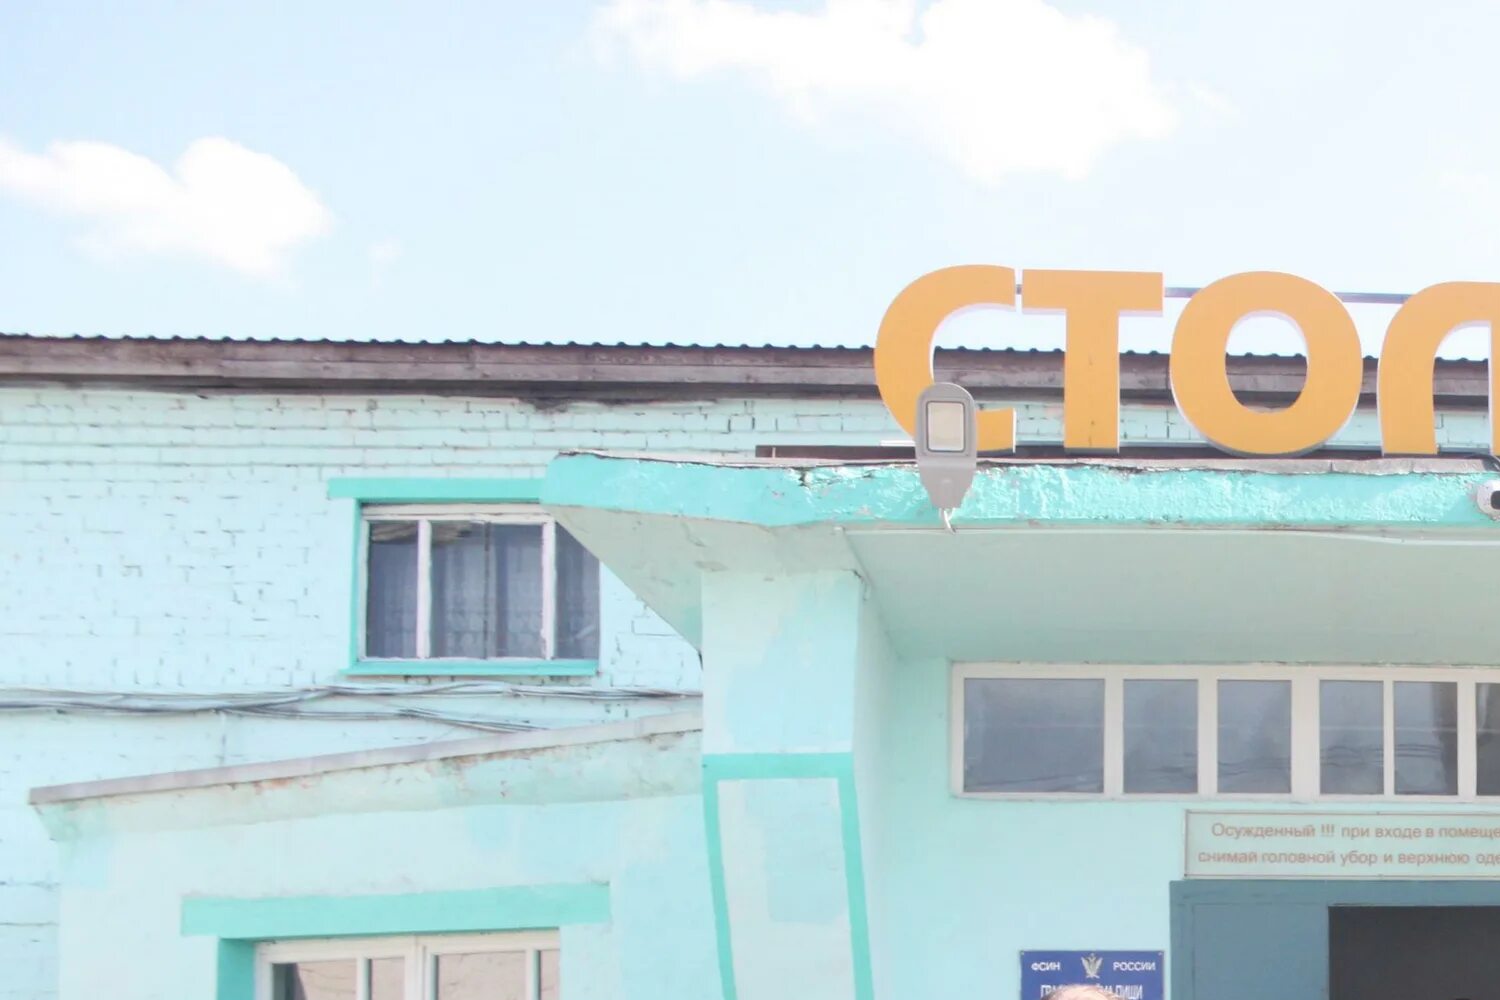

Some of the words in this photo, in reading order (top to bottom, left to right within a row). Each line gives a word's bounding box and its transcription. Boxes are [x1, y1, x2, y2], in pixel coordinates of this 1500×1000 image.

[1211, 823, 1316, 839] Осужденный
[1321, 824, 1335, 837] !!!
[1341, 826, 1370, 840] при
[1375, 827, 1422, 839] входе
[1426, 829, 1434, 838] в
[1198, 851, 1257, 863] снимай
[1262, 850, 1336, 863] головной
[1340, 850, 1378, 866] убор
[1383, 854, 1393, 864] и
[1398, 853, 1470, 867] верхнюю
[1031, 962, 1061, 971] ФСИН
[1113, 962, 1156, 971] РОССИИ
